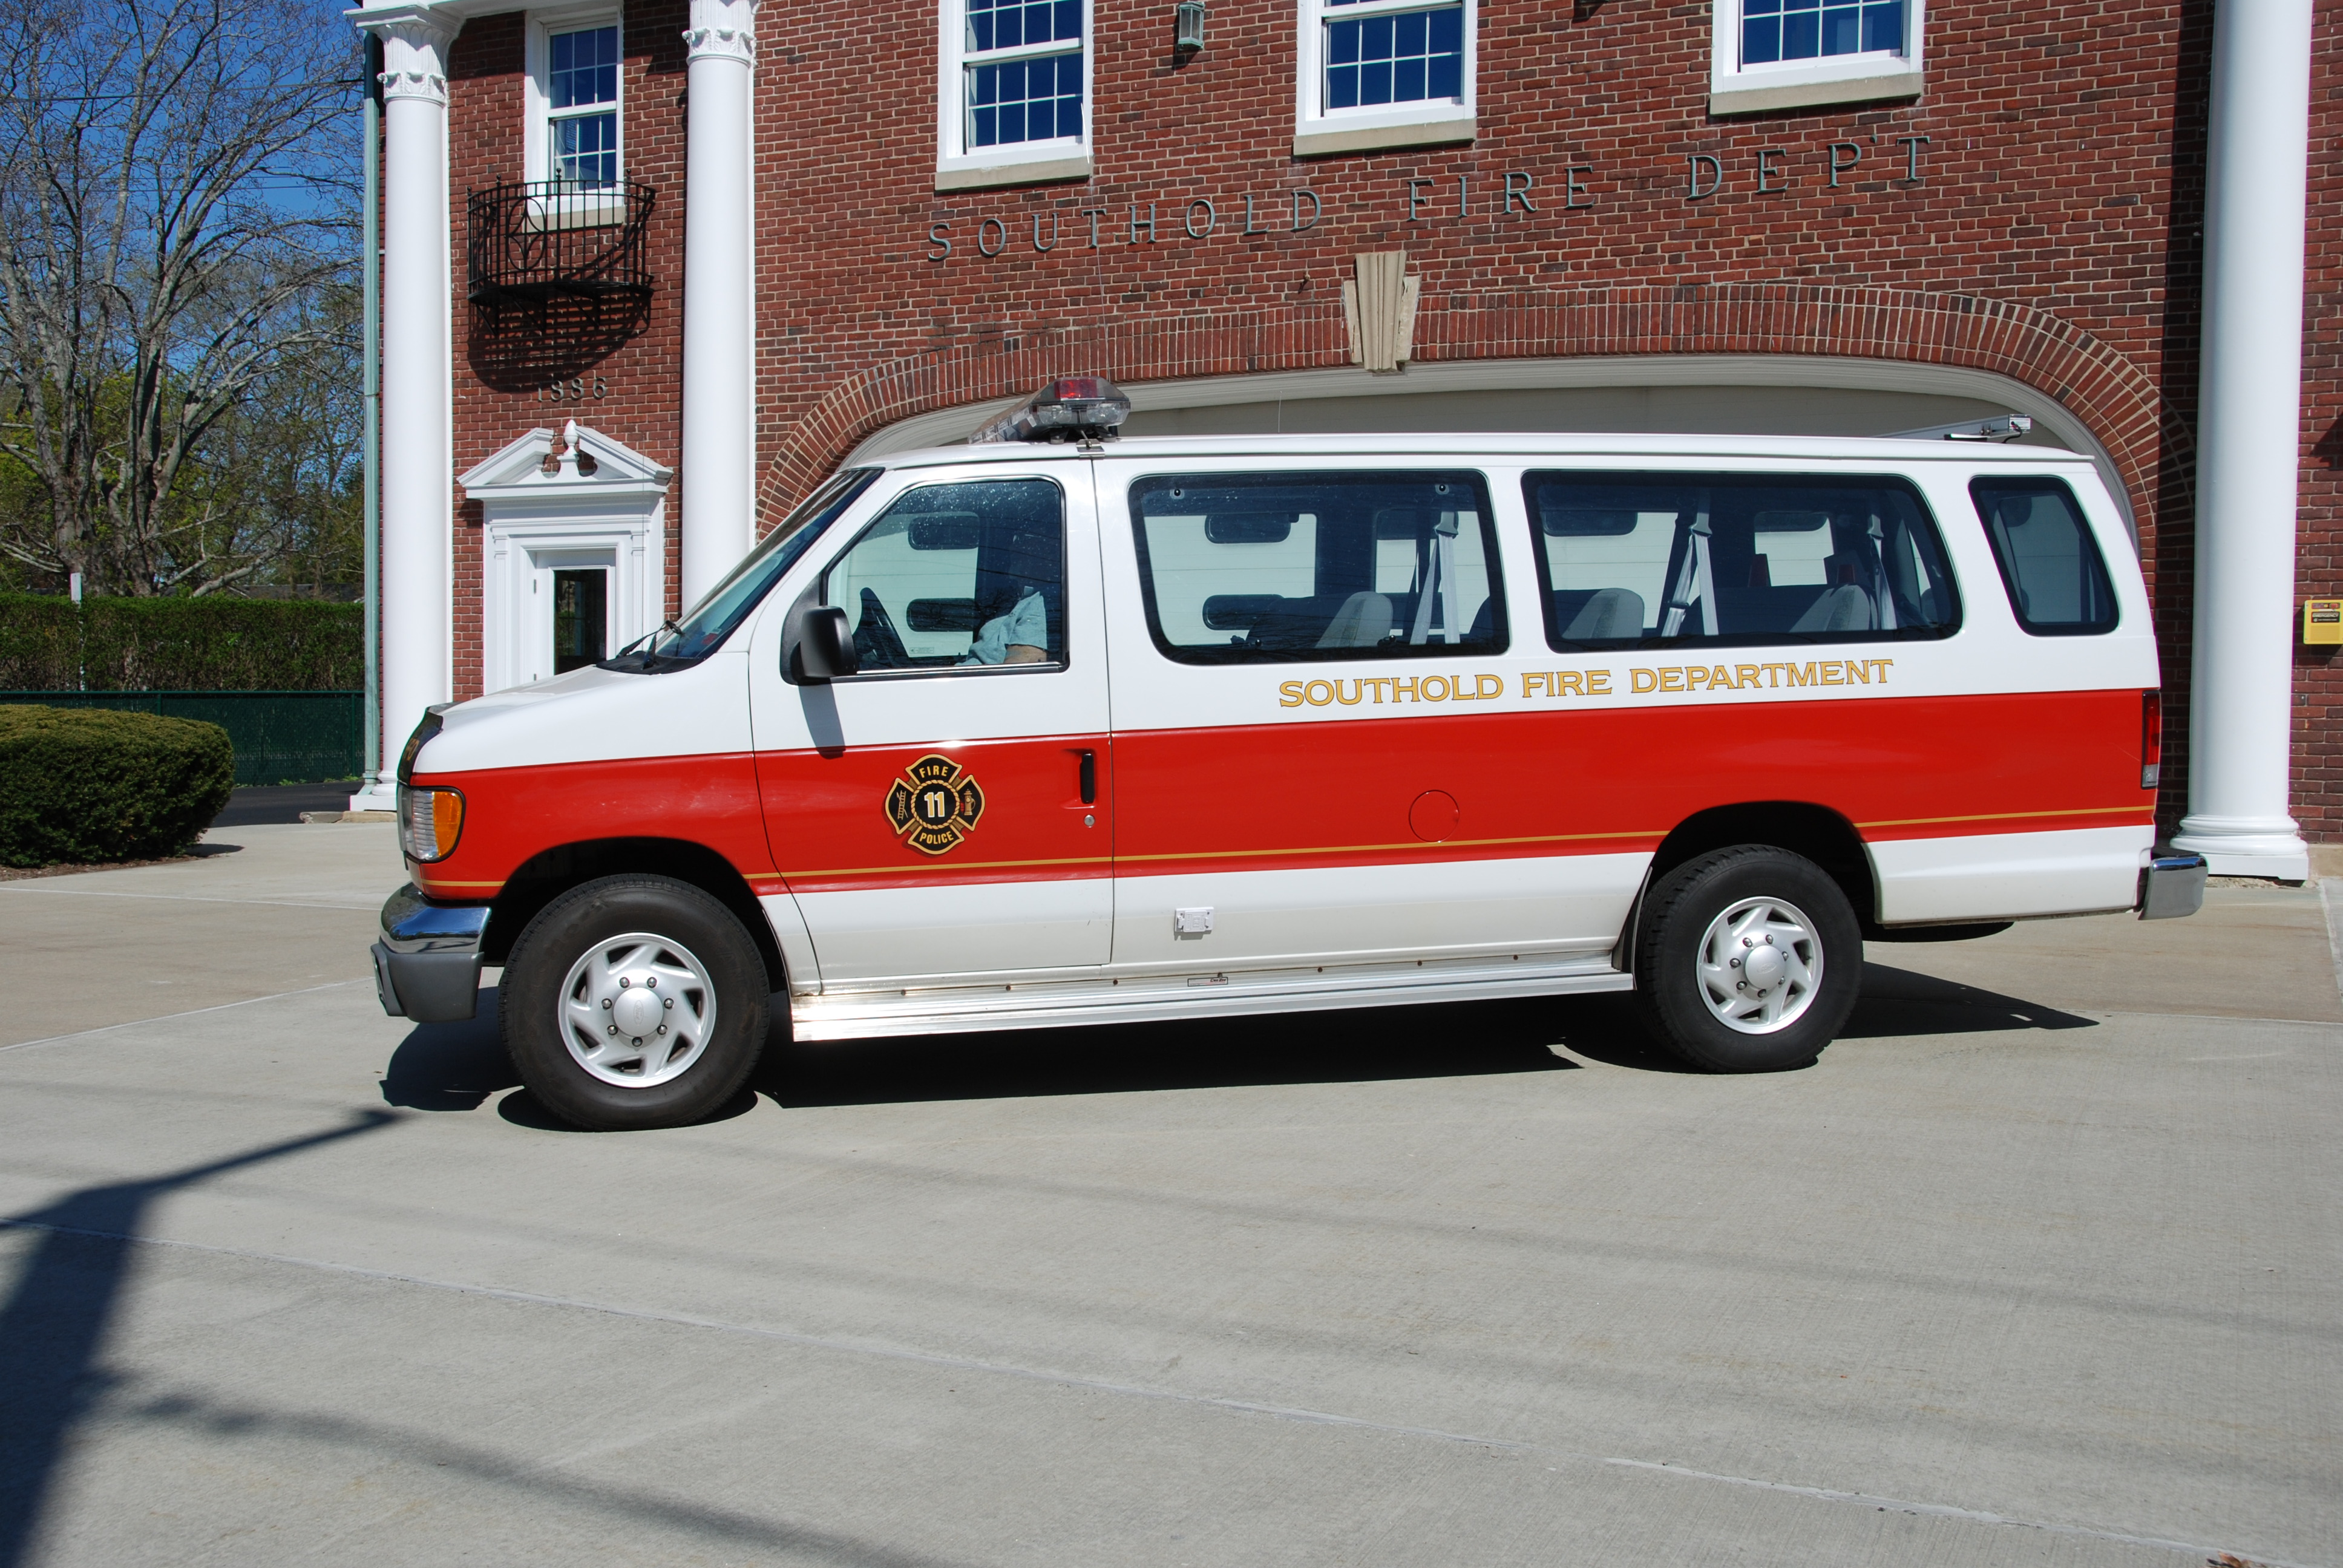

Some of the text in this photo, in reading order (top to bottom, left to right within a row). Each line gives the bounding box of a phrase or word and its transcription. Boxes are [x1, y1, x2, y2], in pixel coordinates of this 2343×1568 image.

[927, 135, 1930, 261] SOUTHOLD FIRE DEP'T
[538, 377, 607, 402] 1886
[1279, 659, 1894, 707] SOUTHOLD FIRE DEPARTMENT
[919, 765, 949, 778] FIRE
[924, 791, 945, 818] 11
[919, 831, 954, 844] POLICE
